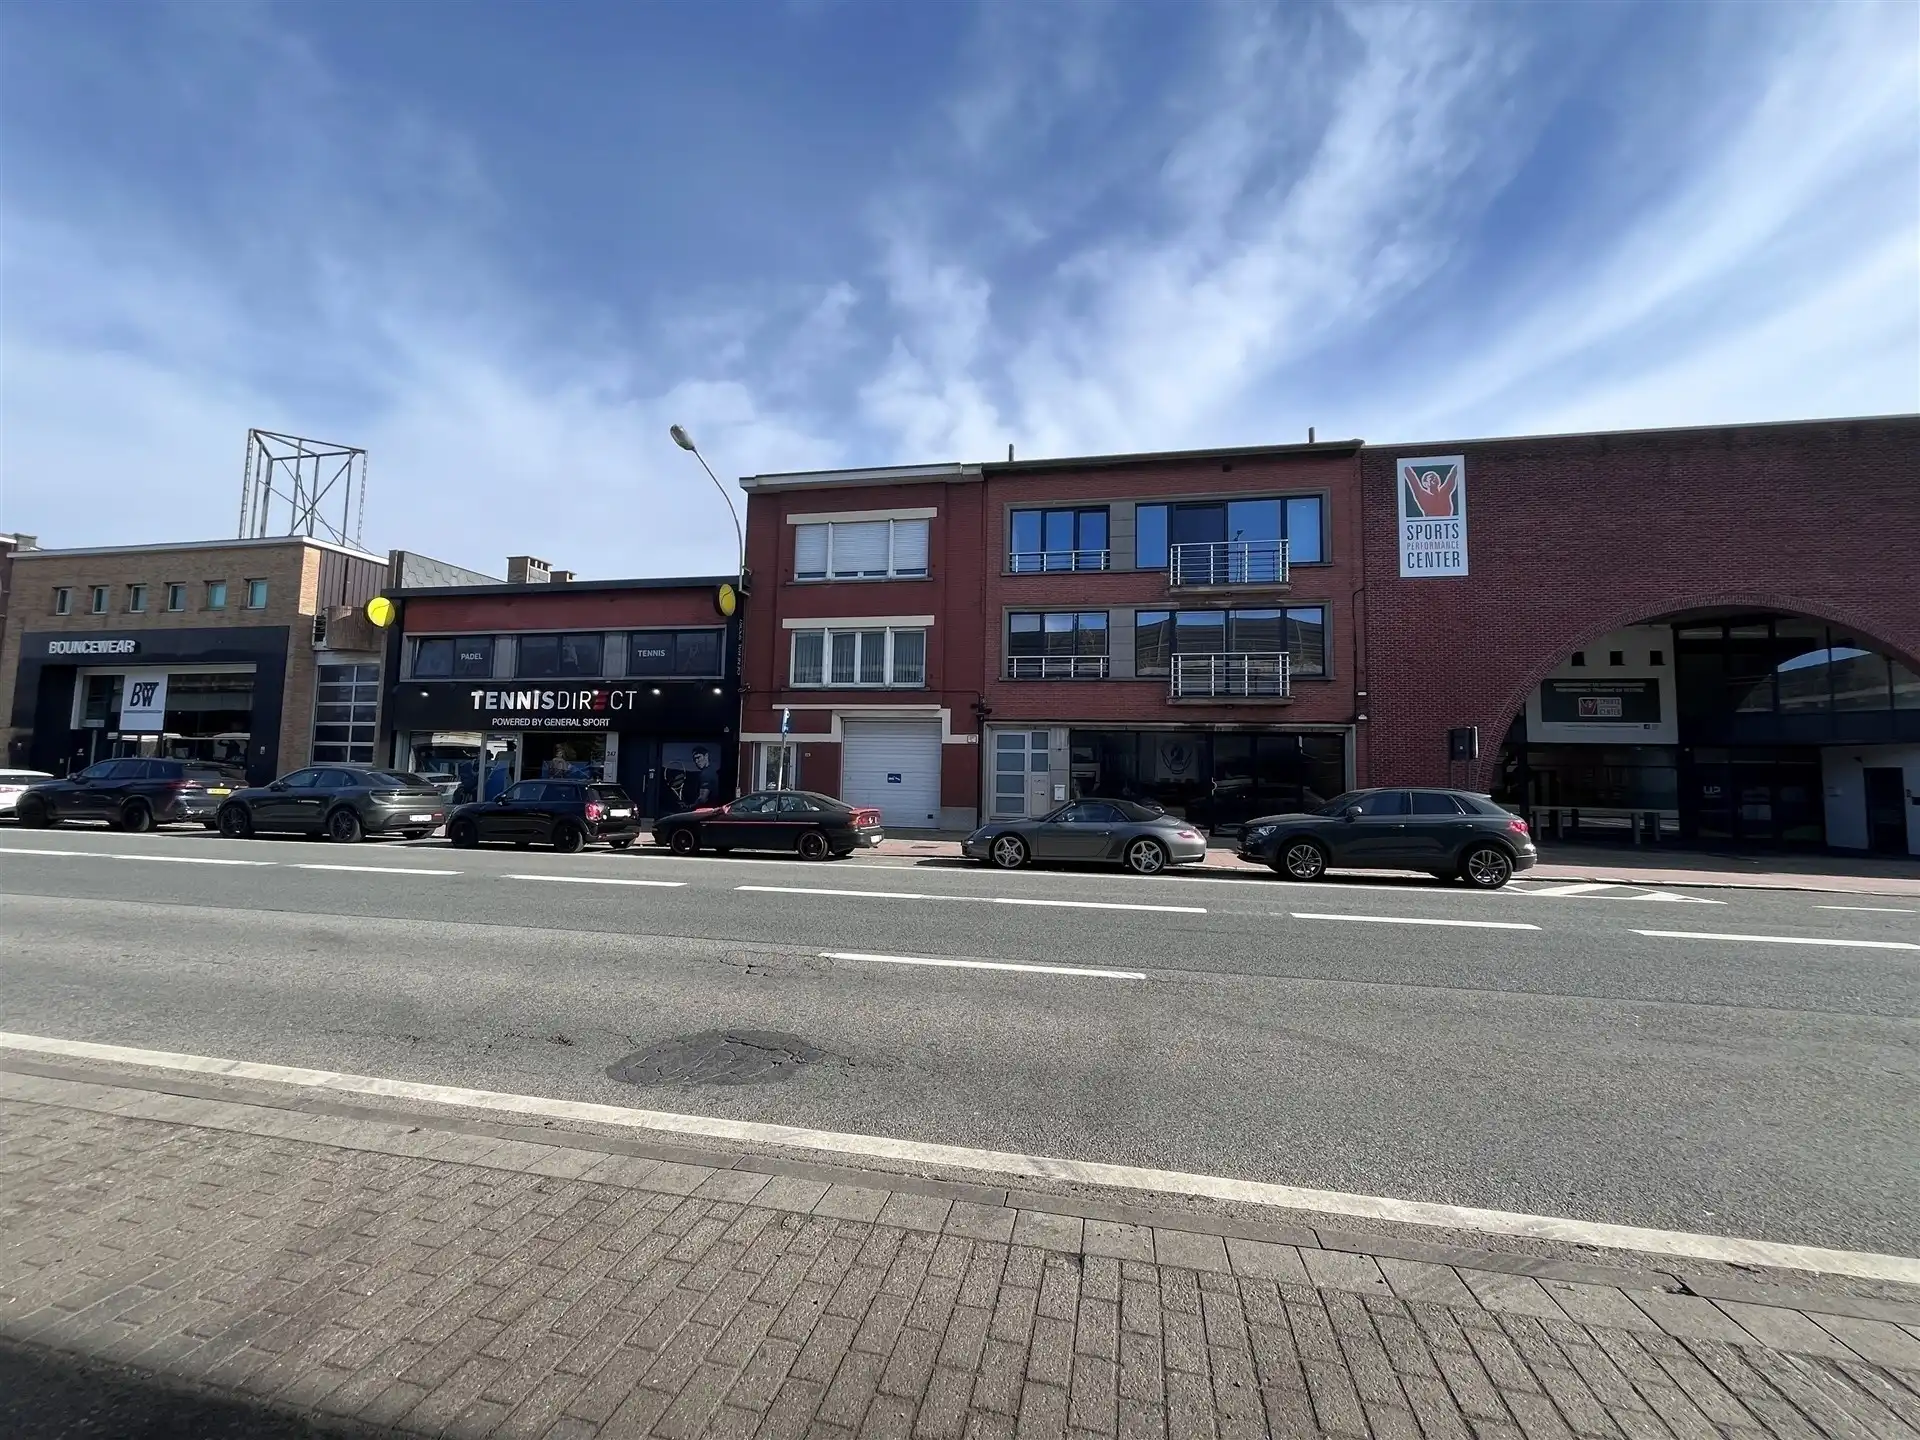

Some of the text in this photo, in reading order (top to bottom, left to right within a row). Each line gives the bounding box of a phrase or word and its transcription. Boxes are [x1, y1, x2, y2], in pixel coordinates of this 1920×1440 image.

[1407, 523, 1459, 540] SPORTS
[1407, 541, 1459, 550] PERFORMANCE
[1408, 551, 1460, 568] CENTER
[48, 640, 135, 654] BOUNCEWEAR
[471, 690, 638, 710] TENNISDIRECT
[492, 718, 610, 727] POWERED BY GENERAL SPORT
